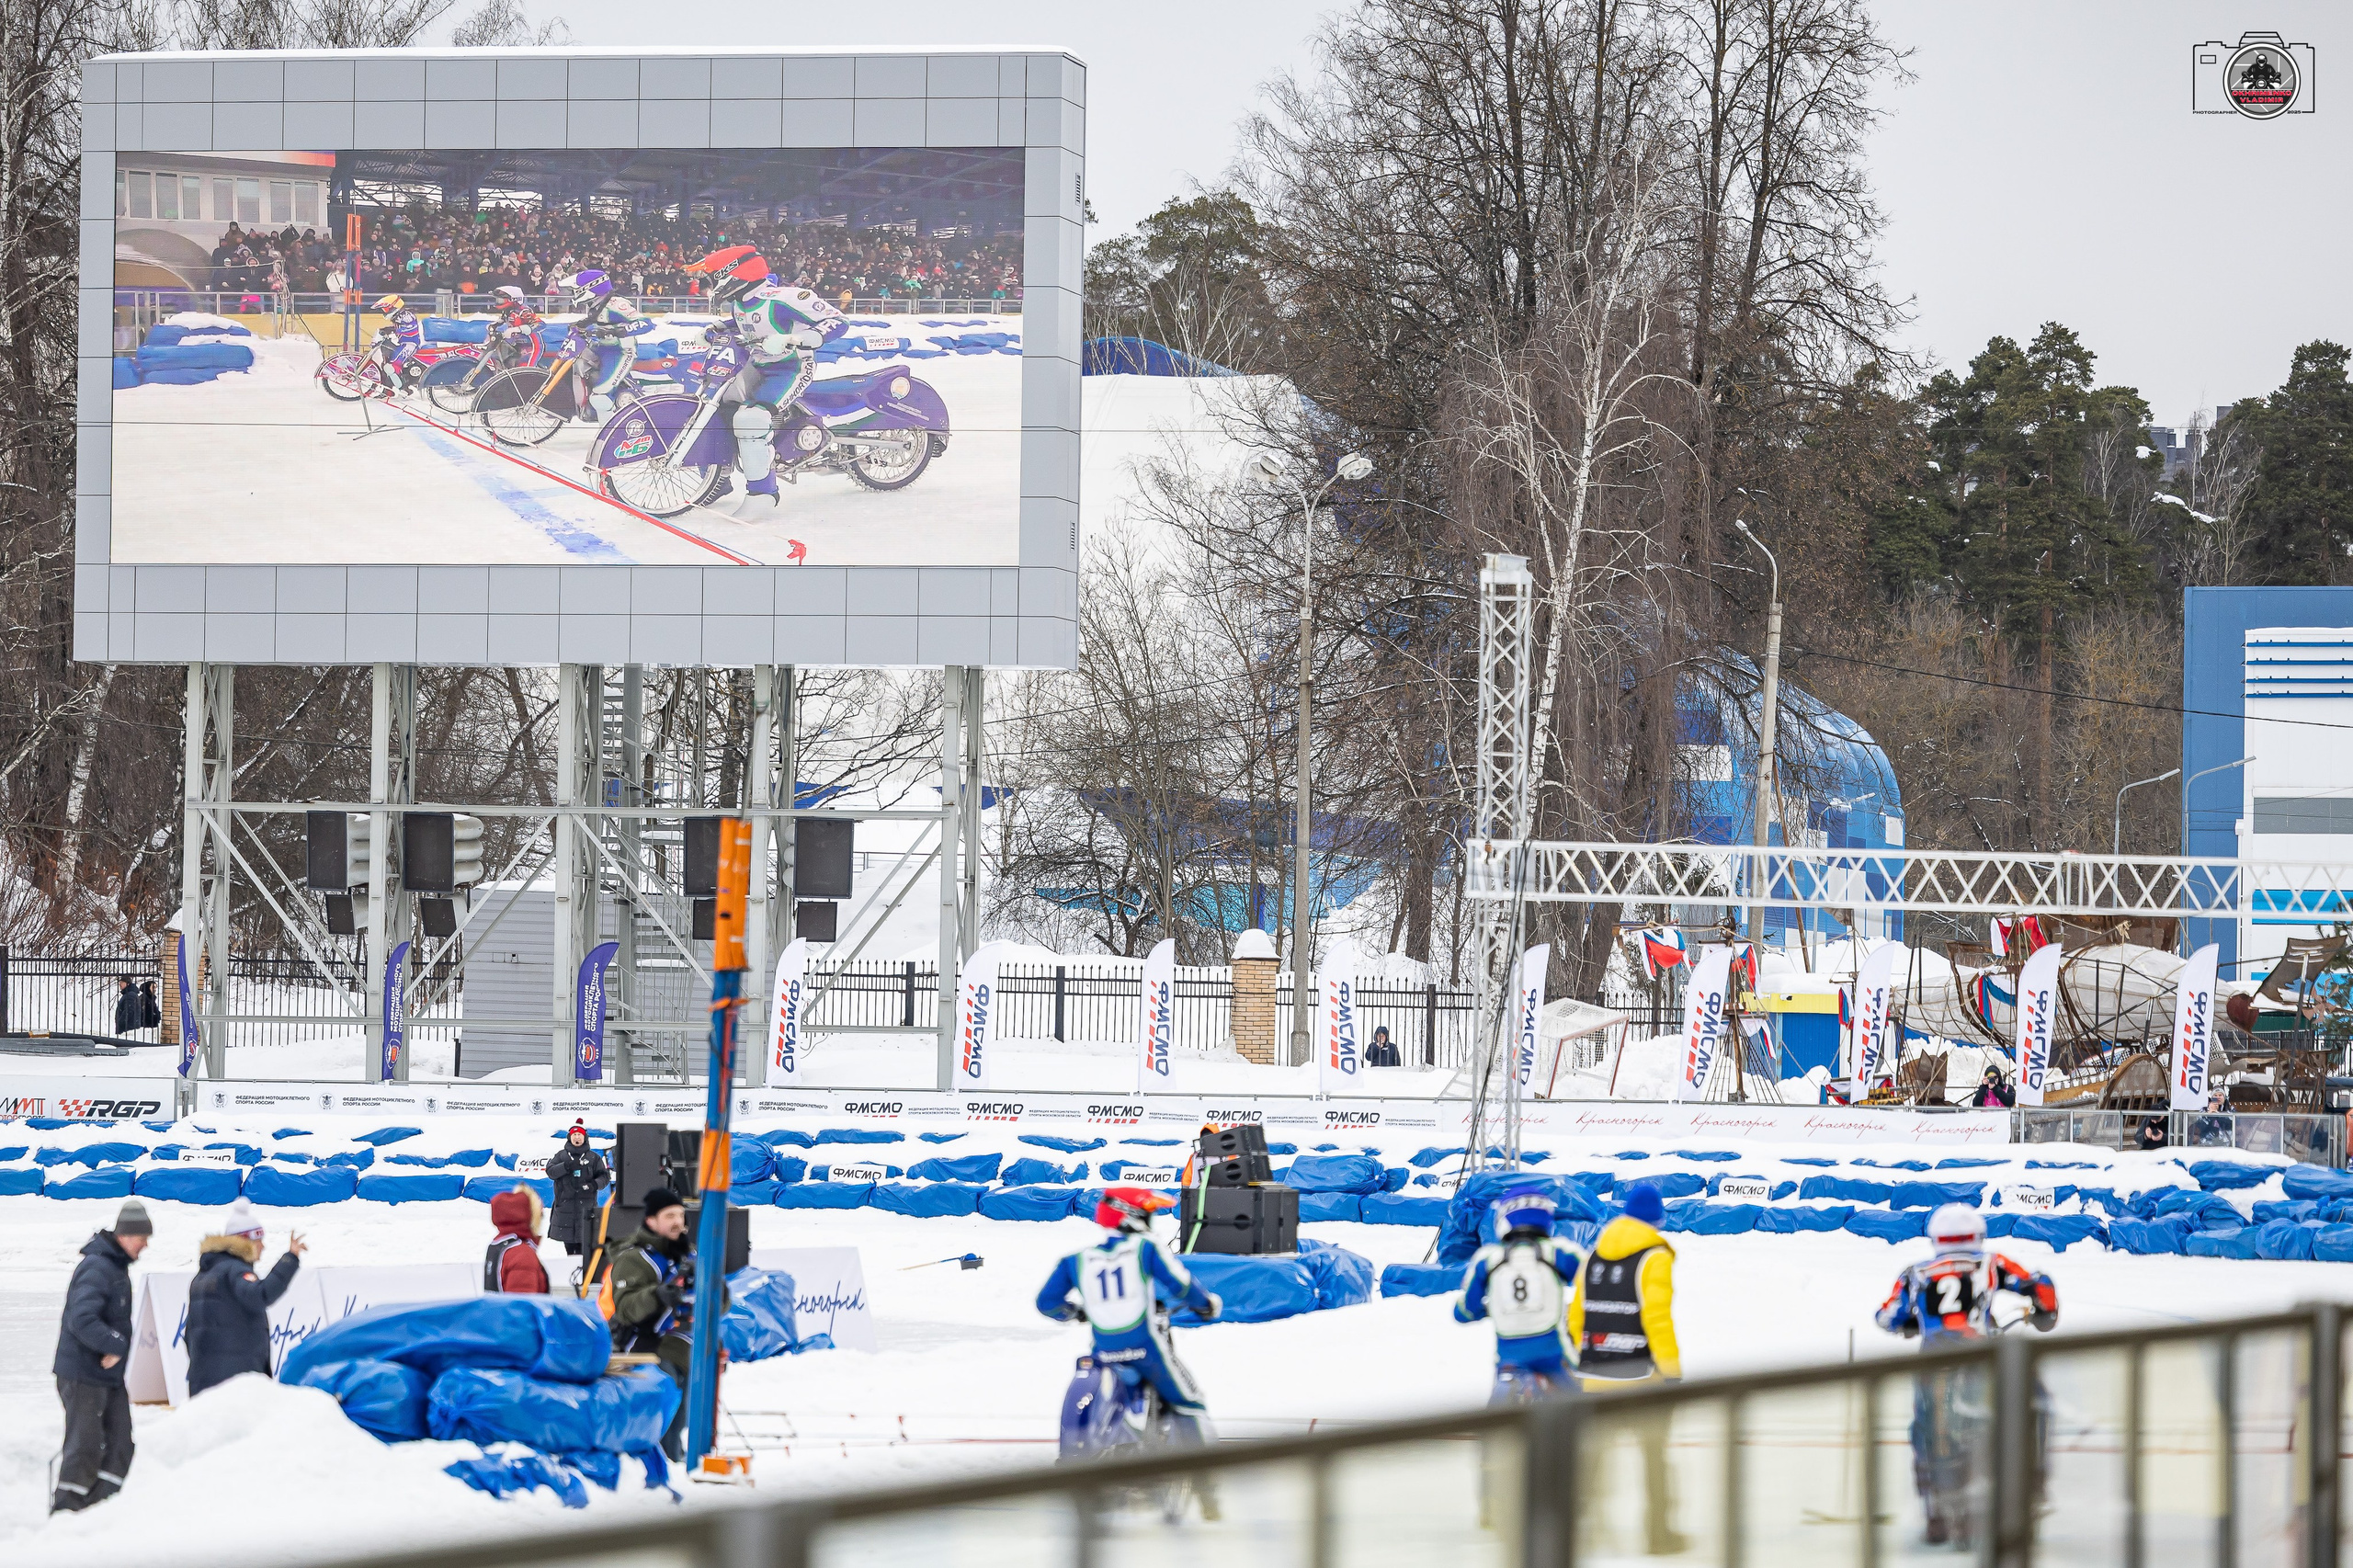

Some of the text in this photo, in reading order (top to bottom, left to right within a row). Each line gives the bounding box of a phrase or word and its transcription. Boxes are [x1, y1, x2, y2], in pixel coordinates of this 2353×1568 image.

[625, 321, 648, 332] UFA
[708, 346, 735, 365] FA
[590, 1003, 599, 1032] СПОРТА
[781, 979, 800, 1074] ФМСМО
[1155, 981, 1170, 1076] ФМСМО
[1339, 981, 1357, 1075] ФМСМО
[968, 983, 990, 1079] ФМСМО
[1692, 992, 1722, 1089] ФМСМО
[2029, 990, 2049, 1090] ФМСМО
[2188, 992, 2208, 1095] ФМСМО
[85, 1100, 161, 1118] RGP
[845, 1103, 903, 1113] ФМСМО
[967, 1103, 1024, 1114] ФМСМО
[1087, 1105, 1143, 1117] ФМСМО
[1206, 1110, 1262, 1121] ФМСМО
[1324, 1111, 1381, 1123] ФМСМО
[1575, 1111, 1664, 1134] Красногорск
[1690, 1112, 1777, 1136] Красногорск
[1804, 1115, 1886, 1139] Красногорск
[1911, 1120, 1996, 1142] Красногорск
[833, 1168, 881, 1179] ФМСМО
[1124, 1174, 1171, 1183] ФМСМО
[1723, 1185, 1766, 1195] ФМСМО
[2017, 1194, 2052, 1204] МСМО
[1097, 1267, 1125, 1301] 11
[1513, 1277, 1528, 1301] 8
[1937, 1275, 1962, 1314] 2
